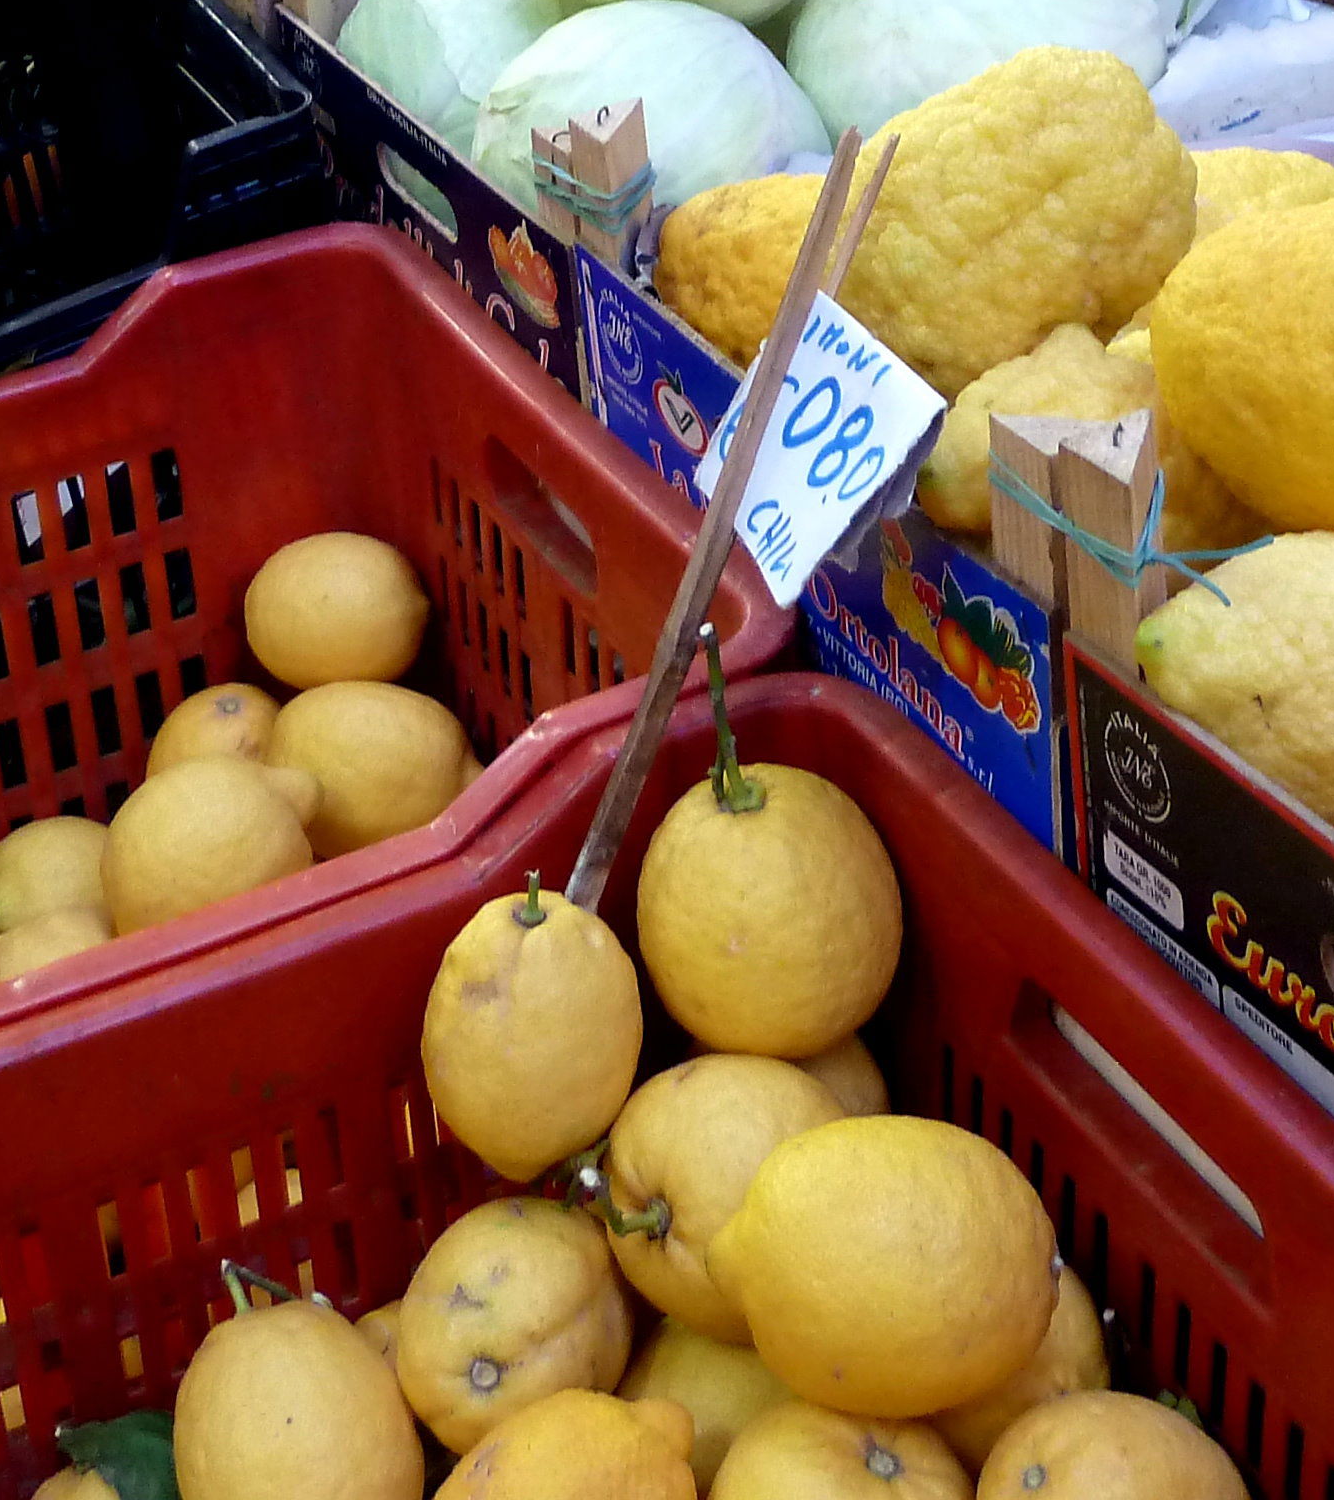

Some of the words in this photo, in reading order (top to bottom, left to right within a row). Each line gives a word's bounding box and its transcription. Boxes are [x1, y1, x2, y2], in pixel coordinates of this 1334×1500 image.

[802, 314, 892, 388] IMONI
[807, 566, 966, 761] Ortolana
[822, 630, 878, 692] VITTORIA
[1110, 710, 1160, 761] ITALIA
[1233, 995, 1295, 1057] SPEDITORE
